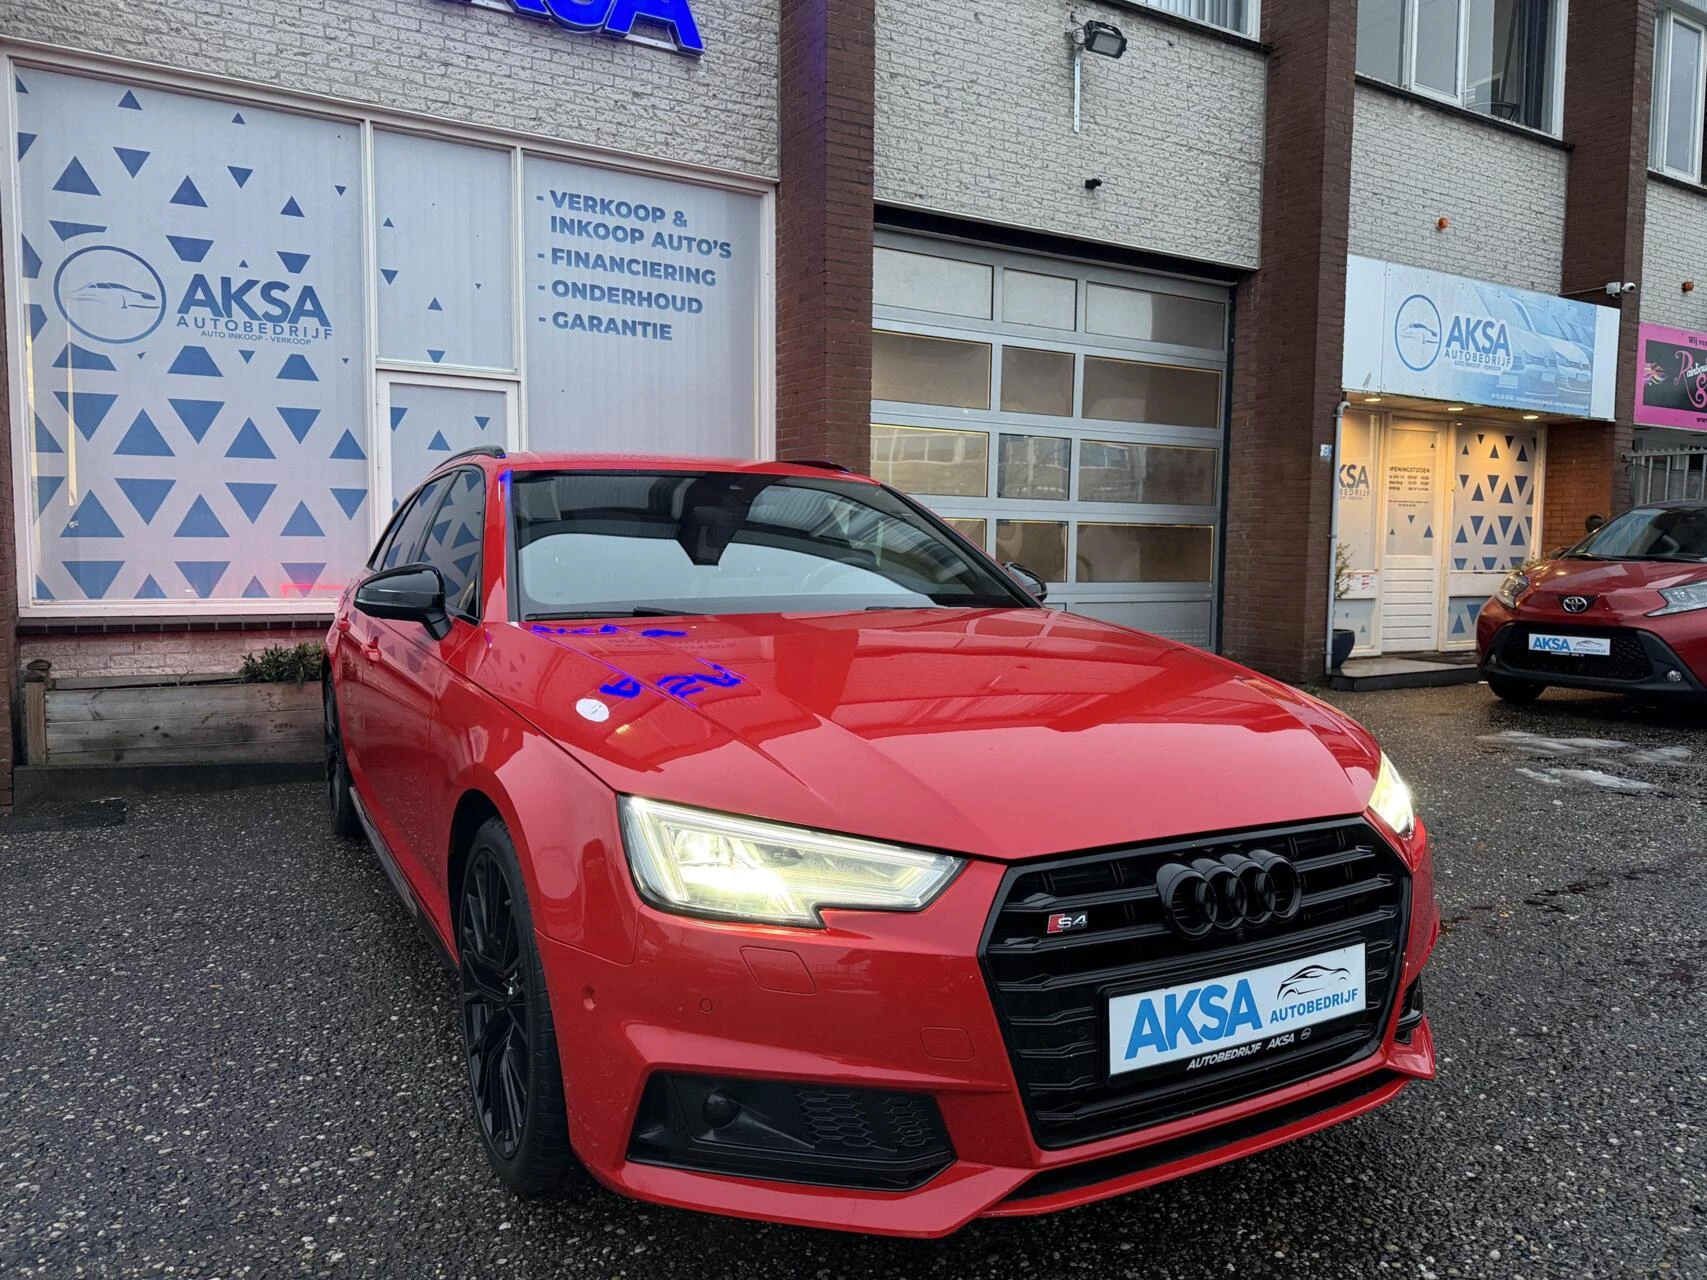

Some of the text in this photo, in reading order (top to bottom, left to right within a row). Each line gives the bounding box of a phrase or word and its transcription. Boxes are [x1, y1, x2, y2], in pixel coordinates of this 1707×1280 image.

[549, 190, 666, 223] VERKOOP
[672, 210, 688, 228] &
[550, 215, 732, 260] INKOOP AUTO'S
[551, 247, 717, 287] FINANCIERING
[177, 273, 332, 328] AKSA
[551, 279, 703, 314] ONDERHOUD
[176, 315, 333, 340] AUTOBEDRIJF
[200, 329, 226, 339] AUTO
[228, 332, 263, 342] INKOOP
[270, 335, 312, 346] VERKOOP
[552, 311, 673, 341] GARANTIE
[1445, 315, 1511, 357] AKSA
[1444, 348, 1512, 367] AUTOBEDRIJF
[1338, 464, 1370, 489] KSA
[1533, 637, 1570, 651] AKSA
[1056, 914, 1088, 929] S4
[1124, 978, 1263, 1061] AKSA
[1269, 987, 1359, 1025] AUTOBEDRIJF
[1186, 1032, 1295, 1071] AUTOBEDRIJF AKSA
